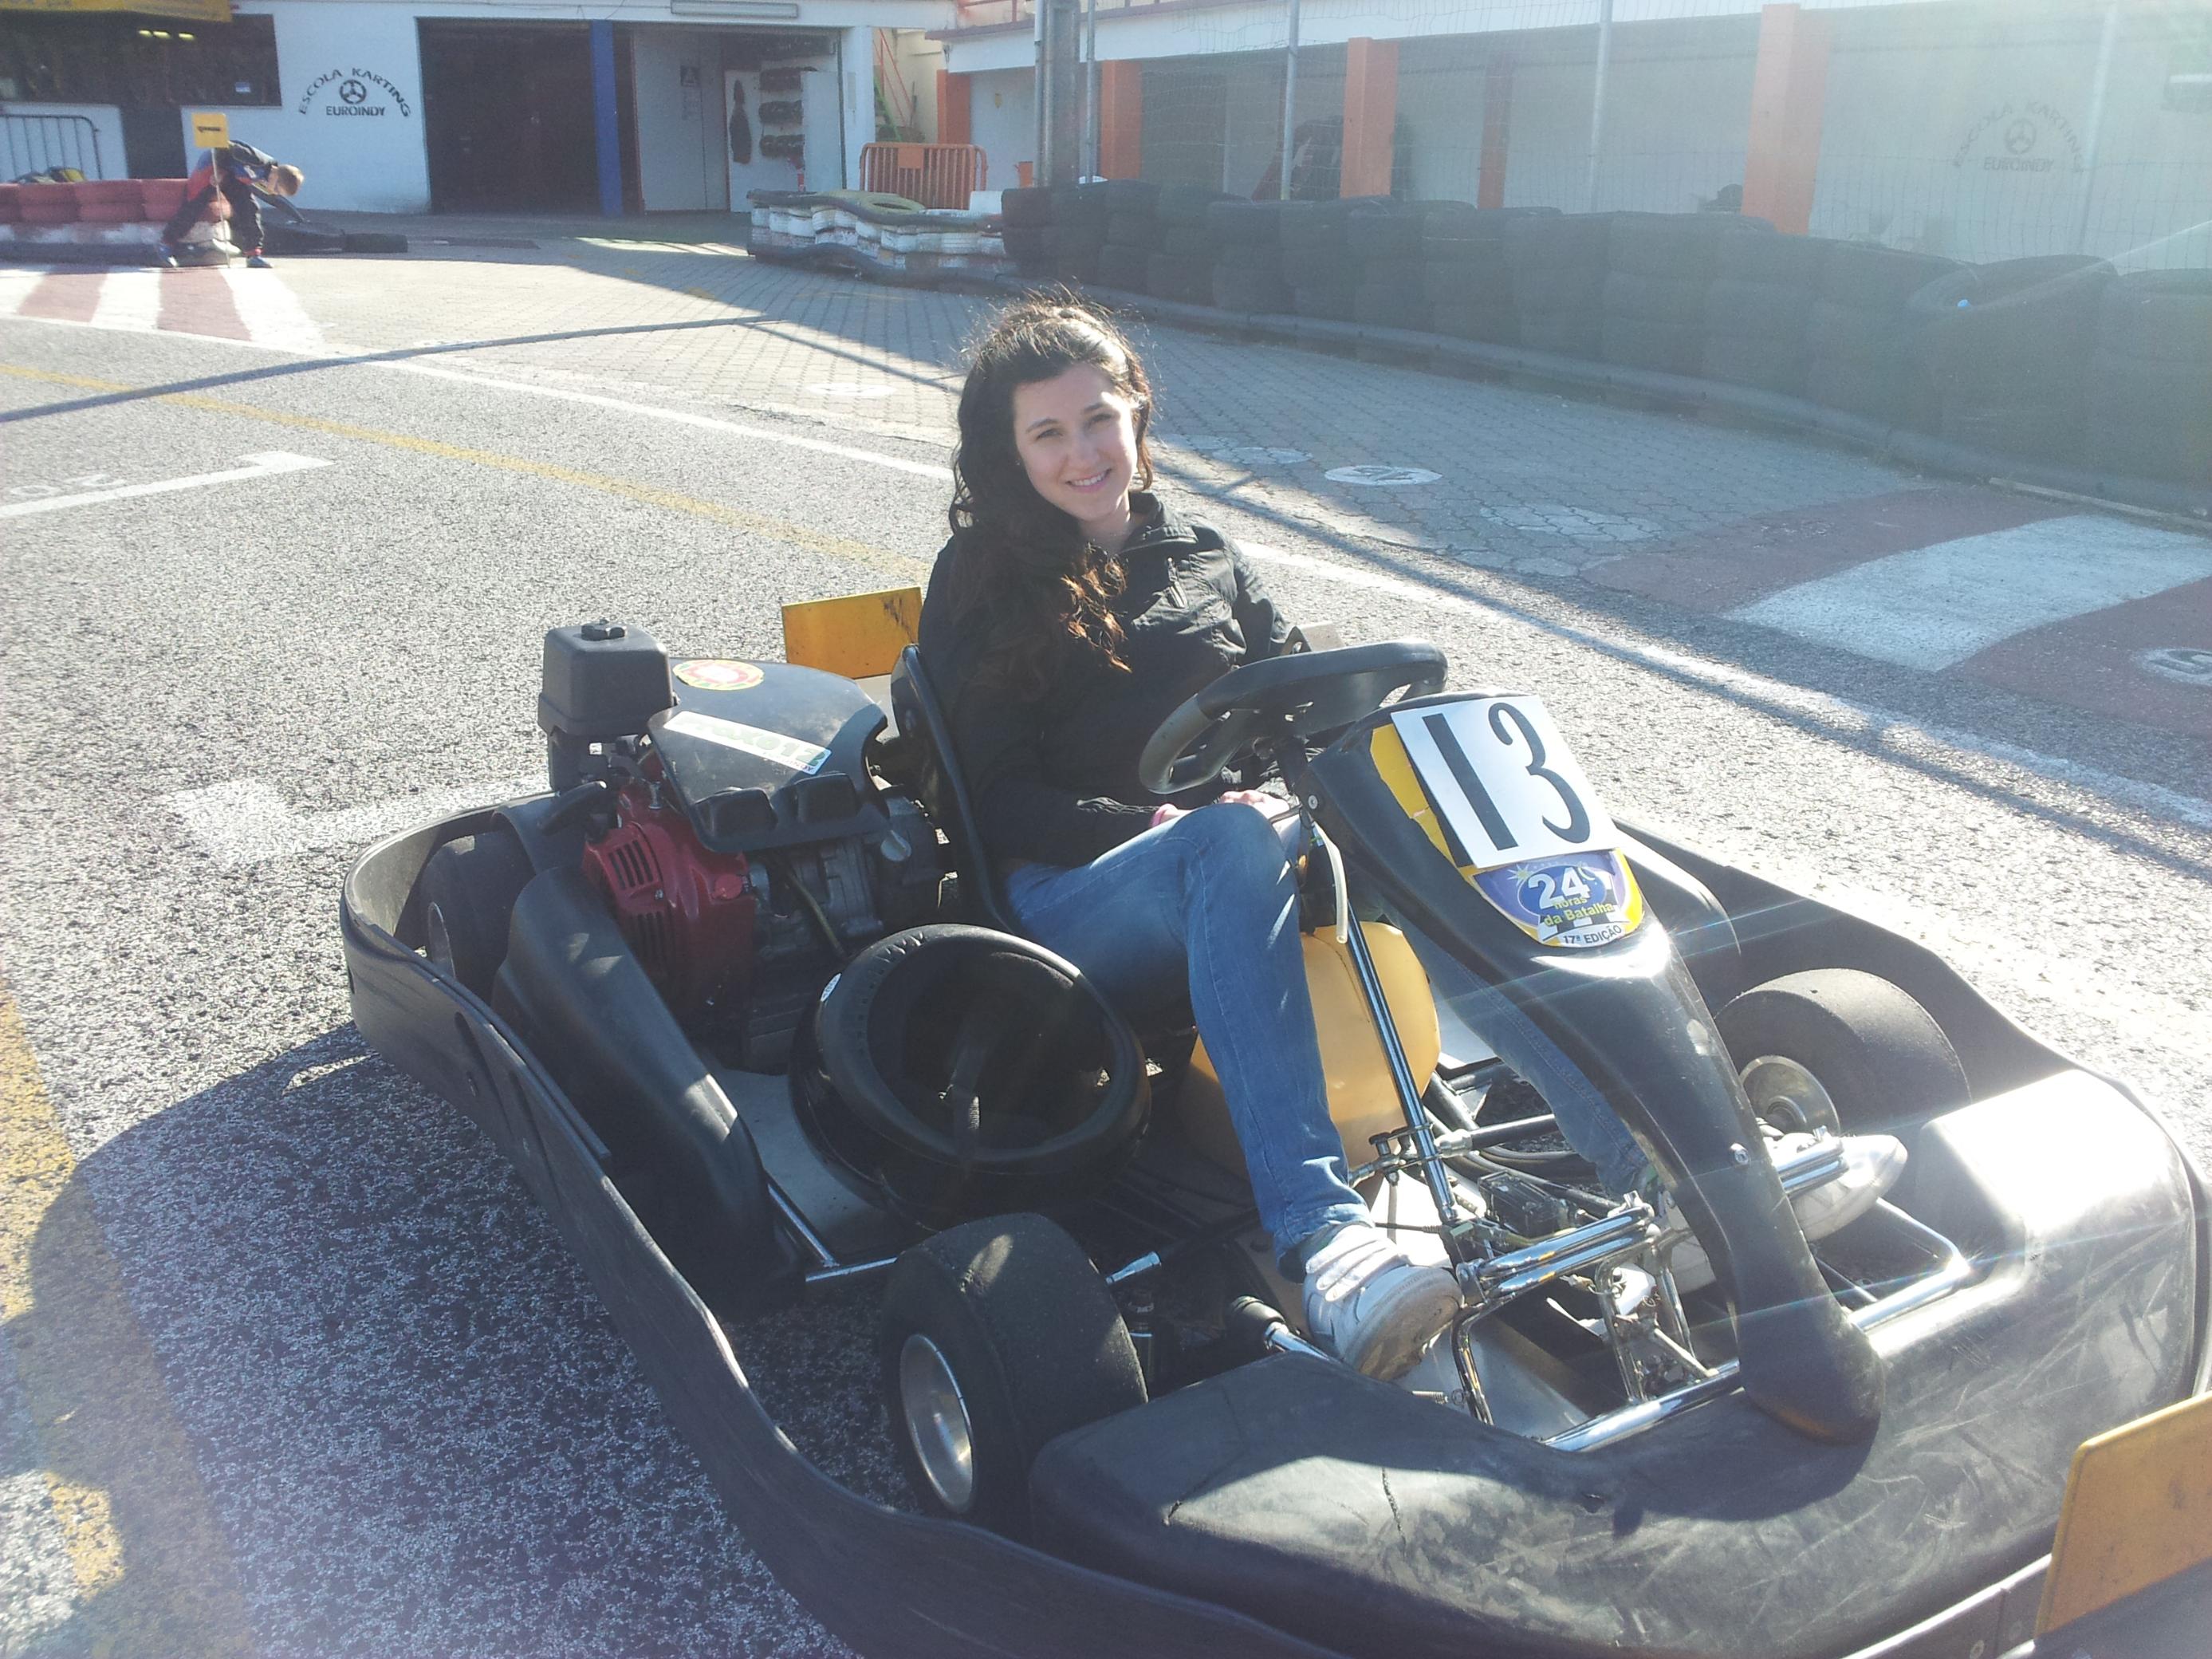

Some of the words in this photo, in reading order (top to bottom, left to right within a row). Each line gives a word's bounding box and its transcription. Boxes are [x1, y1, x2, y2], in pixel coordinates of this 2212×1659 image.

[298, 69, 343, 114] ESCOLA
[352, 68, 411, 116] KARTING
[326, 106, 386, 116] EUROINDY
[1422, 702, 1591, 851] 13
[1528, 867, 1590, 909] 24
[1544, 915, 1563, 926] da
[1565, 901, 1614, 921] Batalha
[1584, 925, 1622, 944] EDIÇÃO
